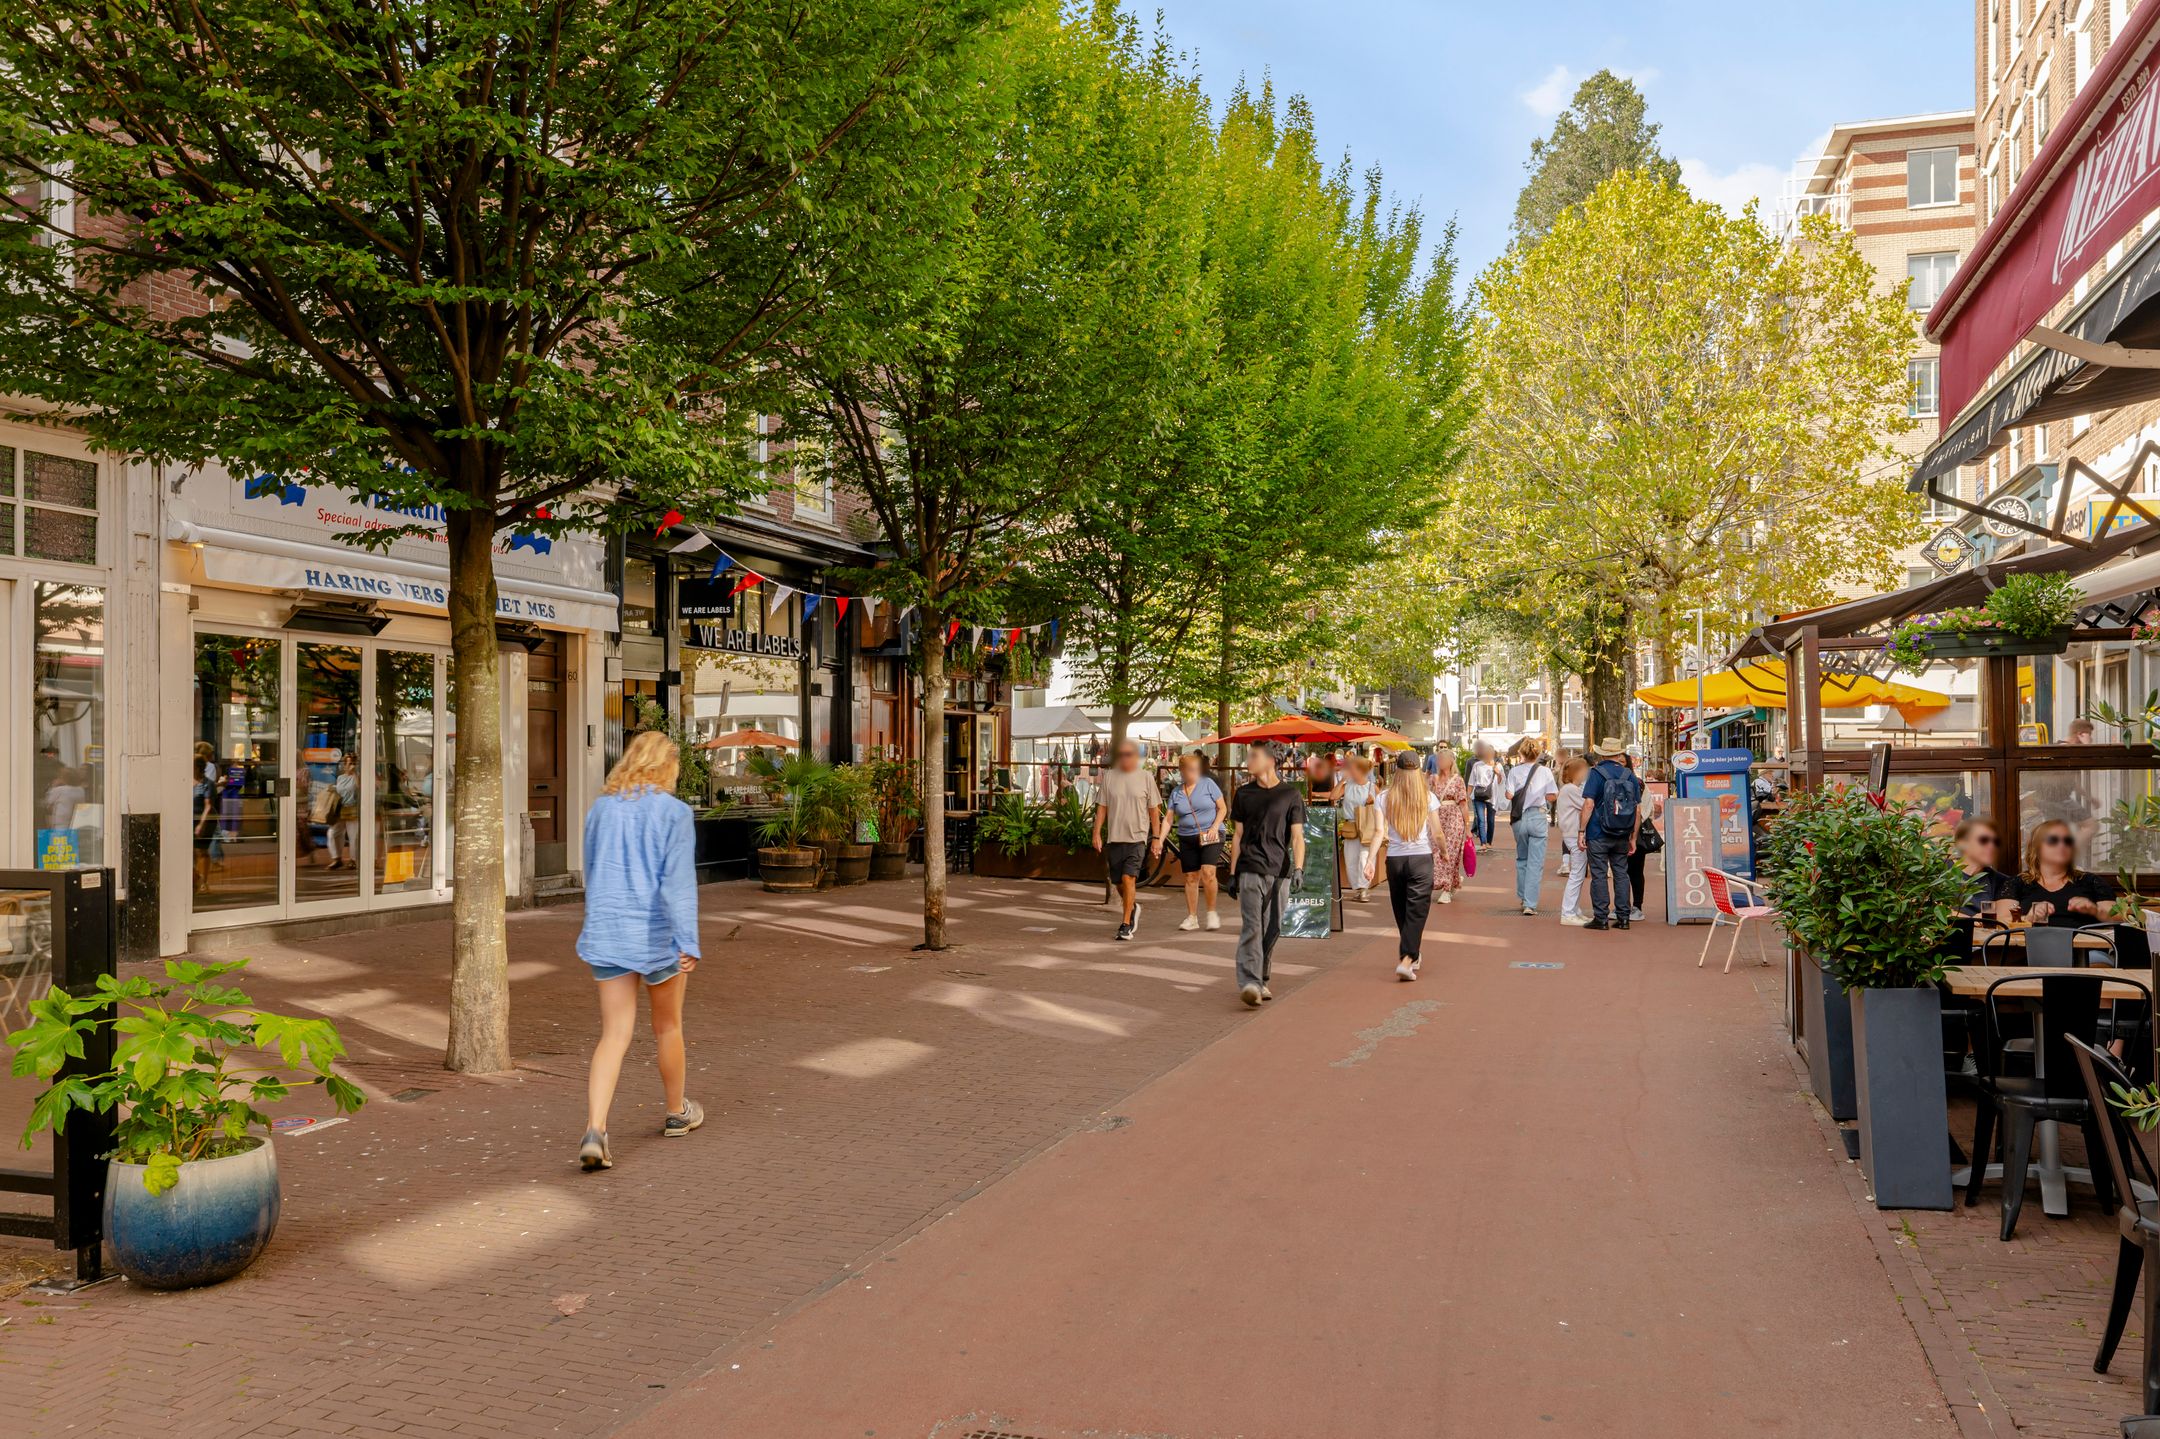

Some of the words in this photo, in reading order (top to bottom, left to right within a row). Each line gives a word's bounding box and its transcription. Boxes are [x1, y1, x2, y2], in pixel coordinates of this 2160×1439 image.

[317, 507, 362, 528] Speciaal
[304, 569, 392, 595] HARING
[396, 582, 445, 603] VERS
[528, 601, 556, 619] MES
[682, 607, 693, 615] WE
[706, 606, 731, 614] LABELS
[699, 624, 723, 648] WE
[726, 629, 753, 652] ARE
[757, 634, 802, 658] LABELS
[567, 671, 577, 682] 60
[1682, 806, 1706, 906] TATTOO
[1295, 898, 1325, 907] LABELS
